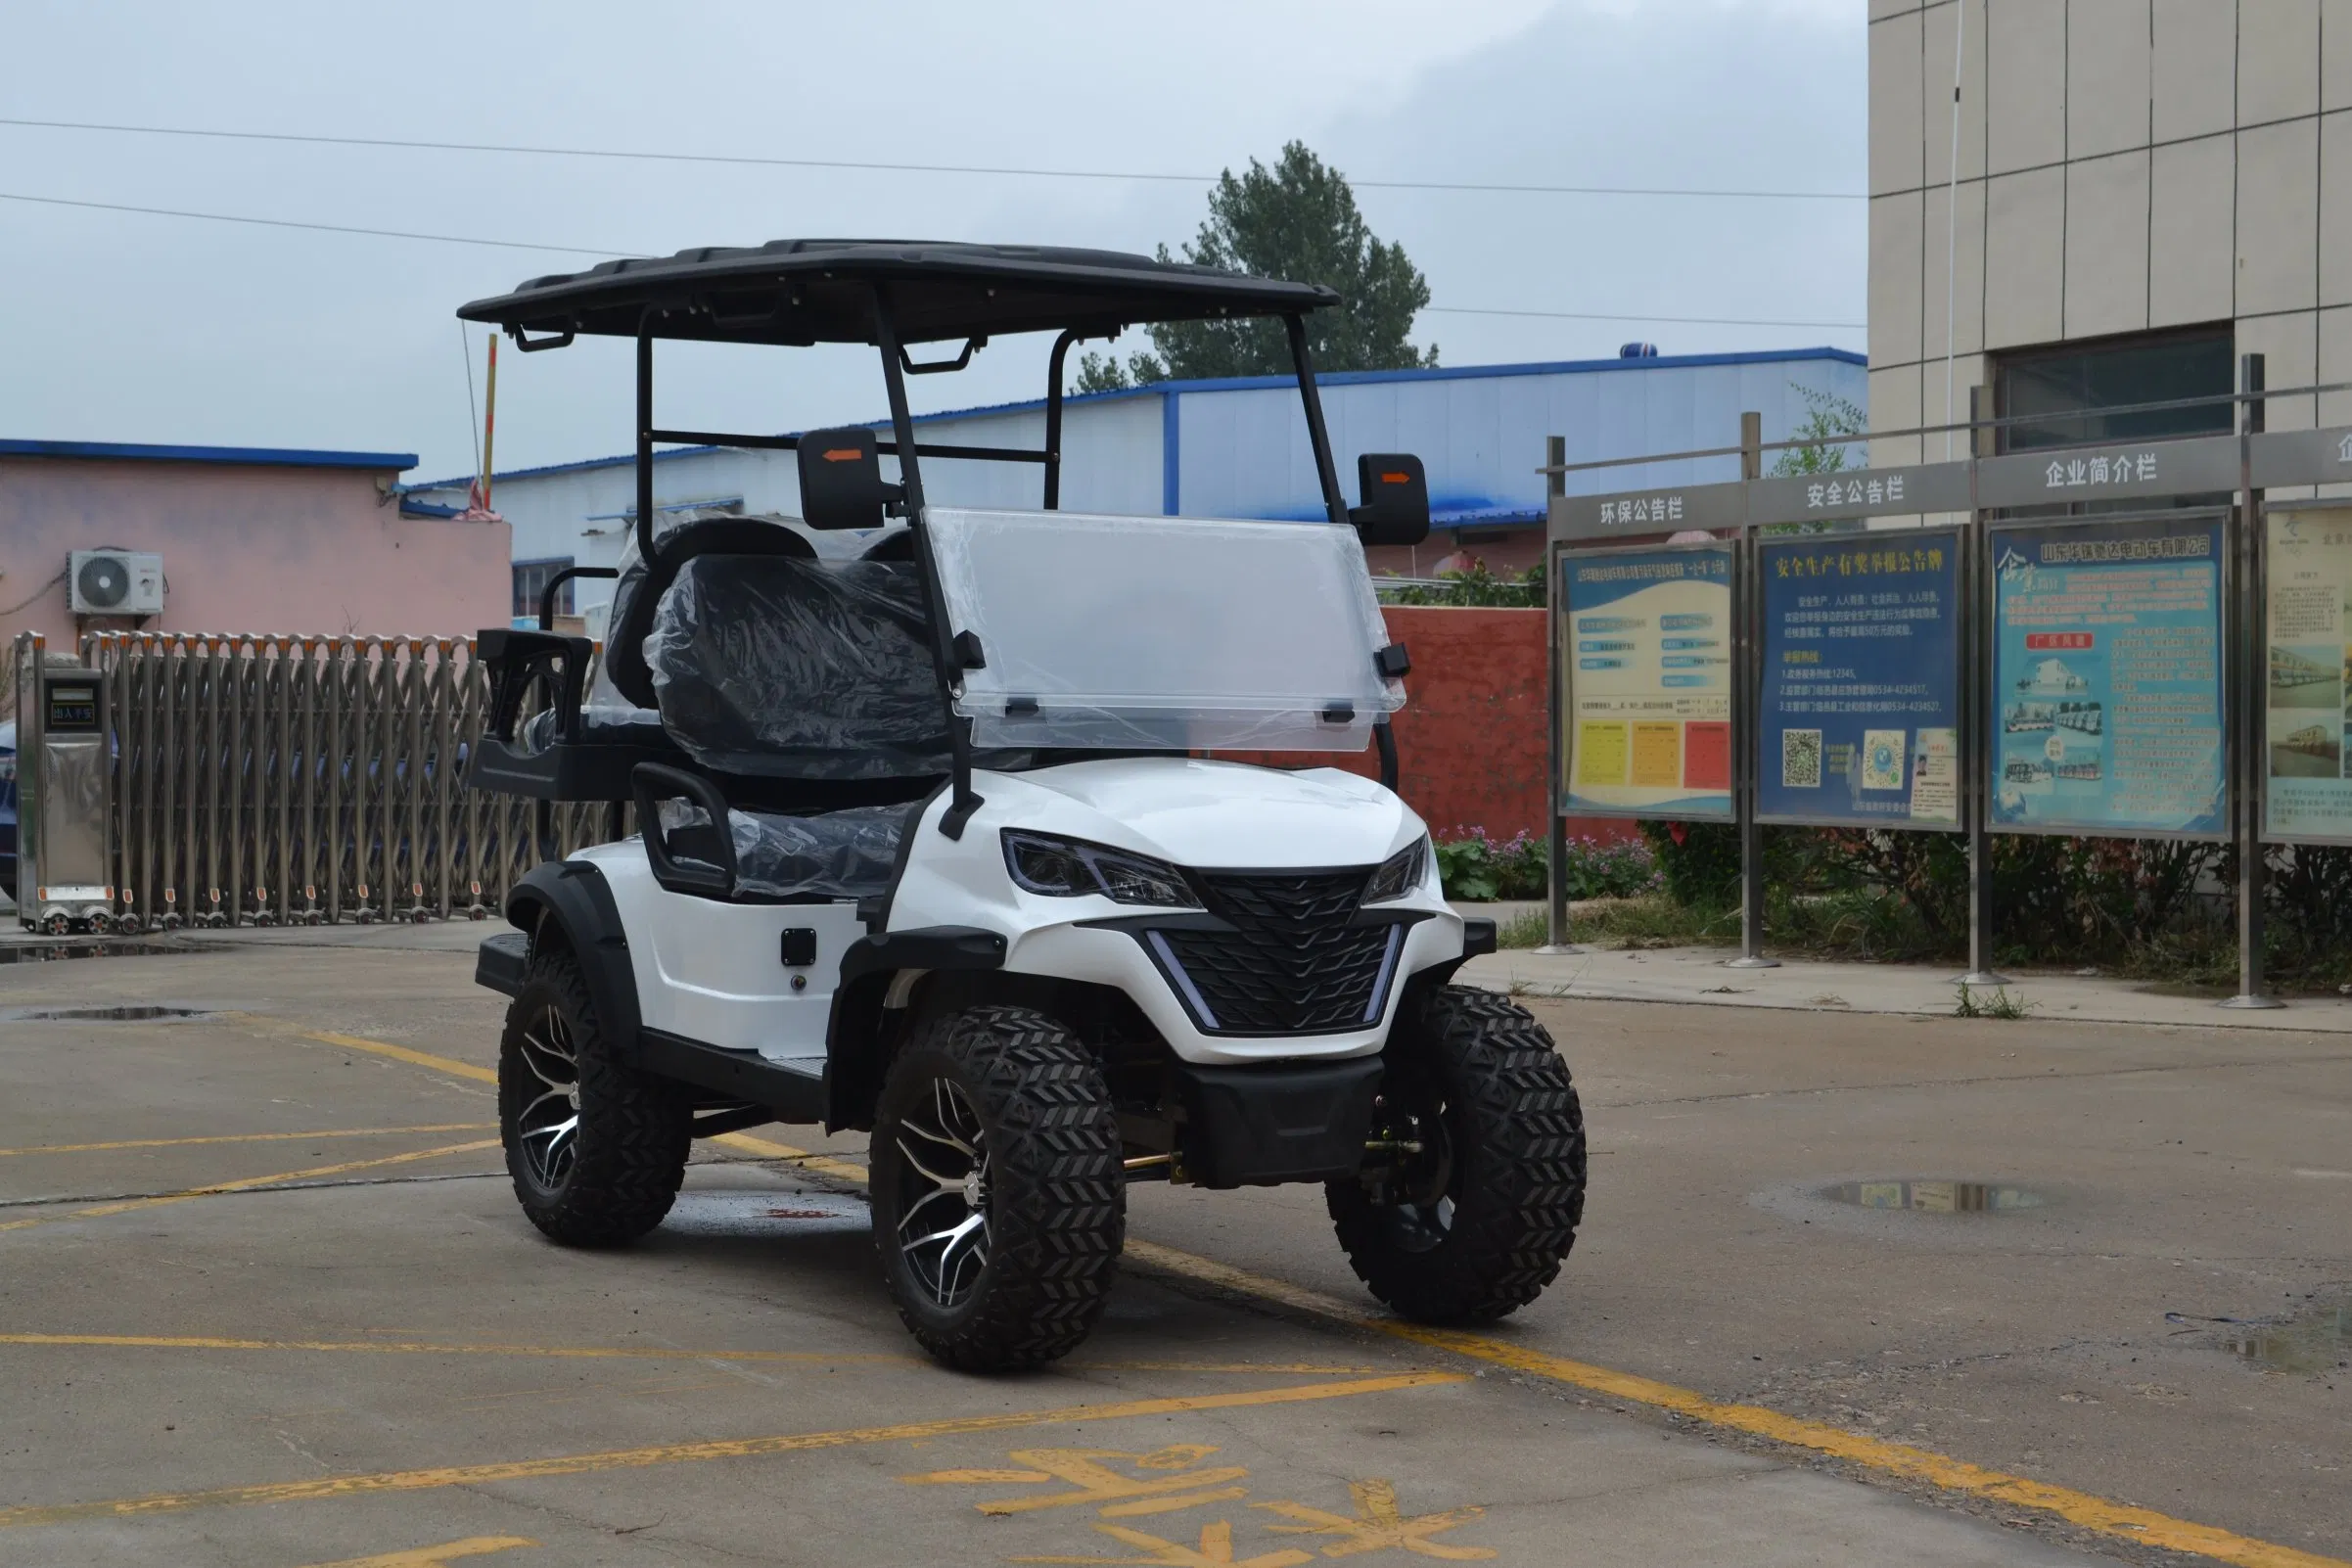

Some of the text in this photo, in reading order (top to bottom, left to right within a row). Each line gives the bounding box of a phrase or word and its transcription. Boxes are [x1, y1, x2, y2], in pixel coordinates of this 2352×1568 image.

[2045, 453, 2157, 488] 企业简介栏
[1807, 475, 1904, 509] 安全公告栏
[1600, 496, 1683, 525] 环保公告栏
[1776, 547, 1943, 578] 安全生产有奖举报公告牌
